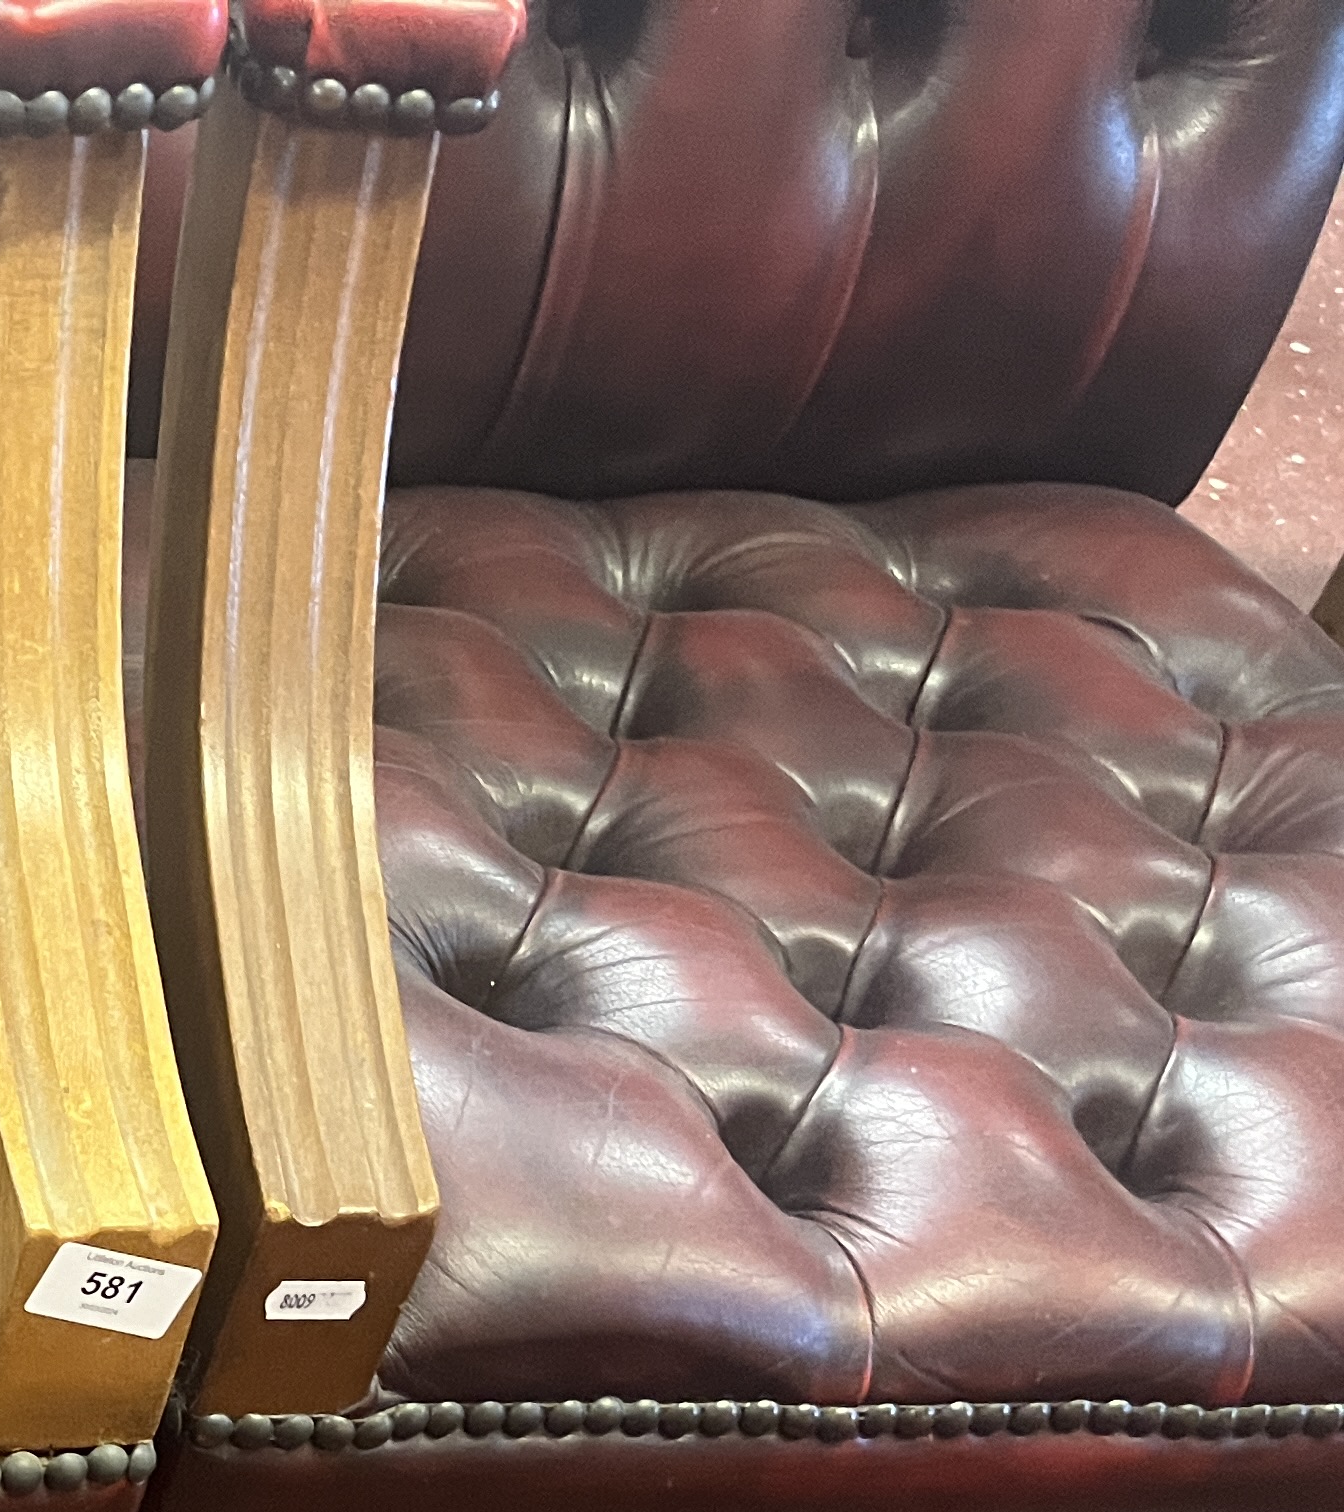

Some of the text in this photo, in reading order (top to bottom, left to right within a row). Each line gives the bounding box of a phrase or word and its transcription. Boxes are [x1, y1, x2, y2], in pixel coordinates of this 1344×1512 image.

[124, 1260, 166, 1276] Auctions
[80, 1271, 144, 1304] 581
[279, 1293, 316, 1309] 8009
